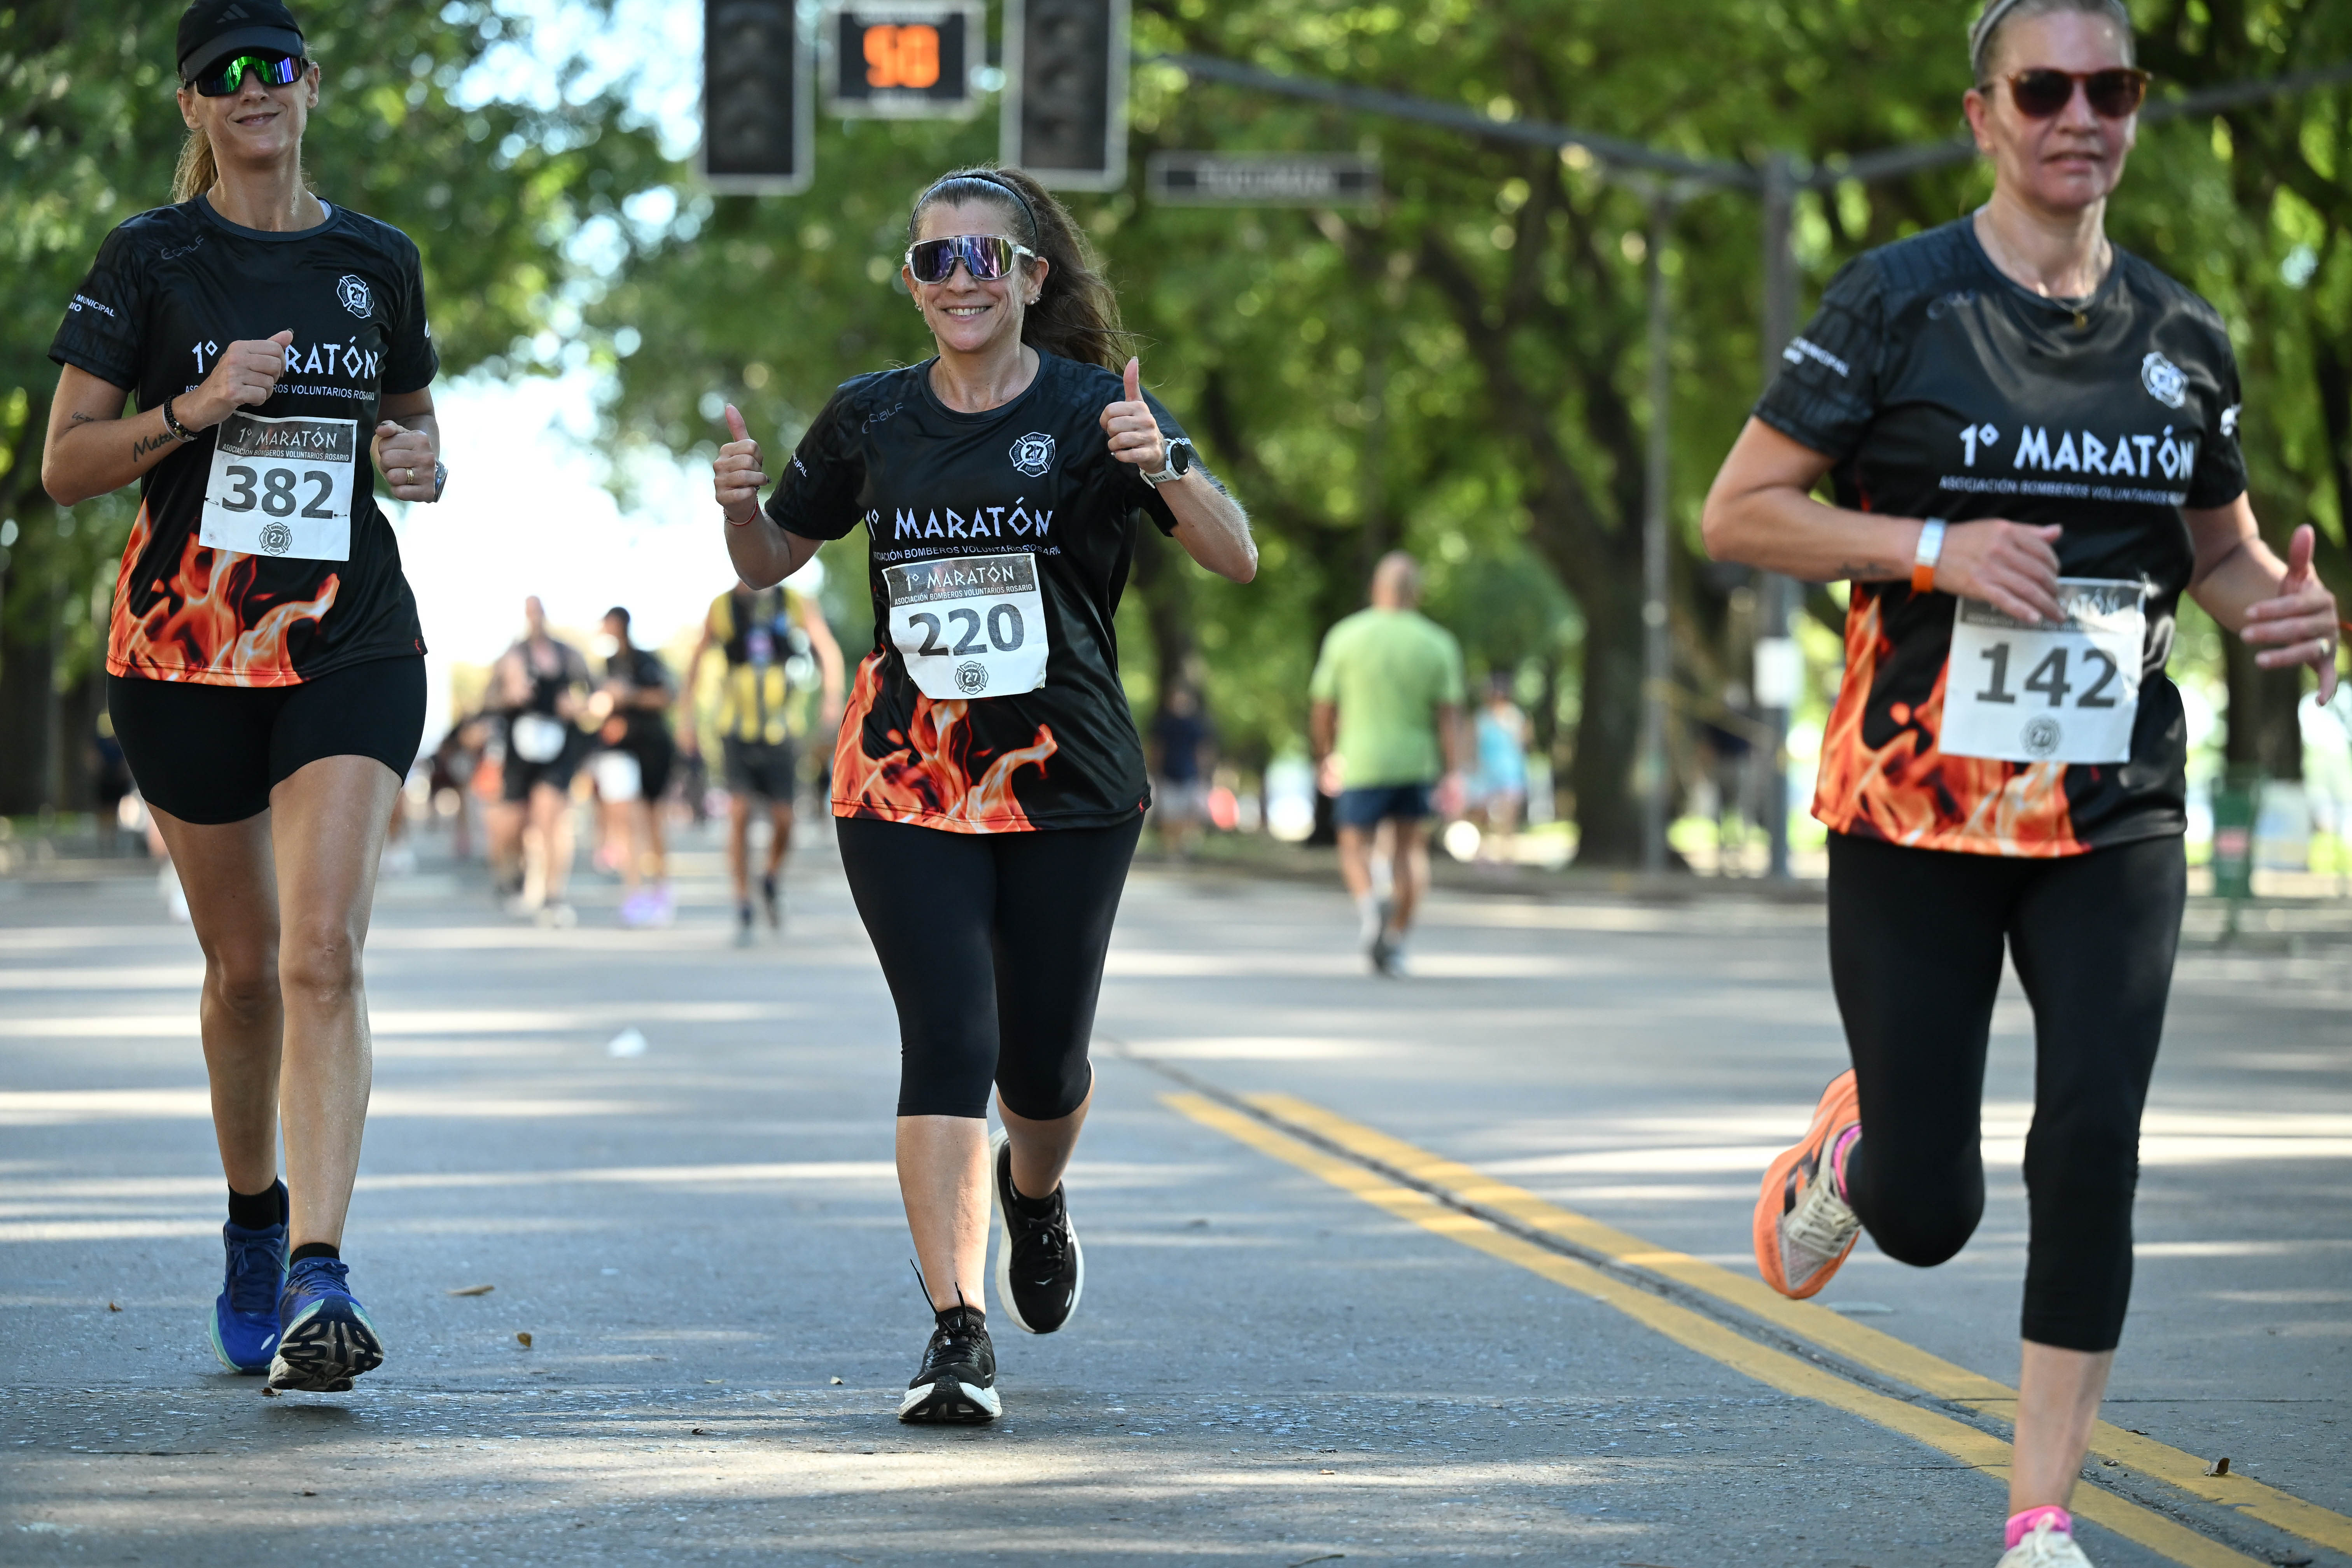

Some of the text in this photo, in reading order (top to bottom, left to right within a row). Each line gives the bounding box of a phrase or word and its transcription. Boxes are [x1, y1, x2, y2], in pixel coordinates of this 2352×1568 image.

[76, 294, 115, 317] MUNICIPAL
[285, 336, 378, 380] RATÓN
[291, 385, 352, 398] VOLUNTARIOS
[354, 390, 374, 401] ROSARIO
[255, 426, 337, 448] MARATÓN
[222, 443, 349, 462] ASOCIACIÓN BOMBEROS VOLUNTARIOS ROSARIO
[1025, 444, 1044, 459] 27
[2013, 424, 2194, 481] MARATÓN
[222, 466, 334, 520] 382
[894, 496, 1053, 540] MARATÓN
[270, 532, 283, 543] 27
[905, 546, 960, 558] BOMBEROS
[962, 544, 1029, 553] VOLUNTARIOS
[927, 561, 1014, 589] MARATÓN
[894, 584, 1032, 606] ASOCIACIÓN BOMBEROS VOLUNTARIOS ROSARIO
[909, 604, 1024, 656] 220
[965, 672, 978, 683] 27
[1976, 642, 2117, 708] 142
